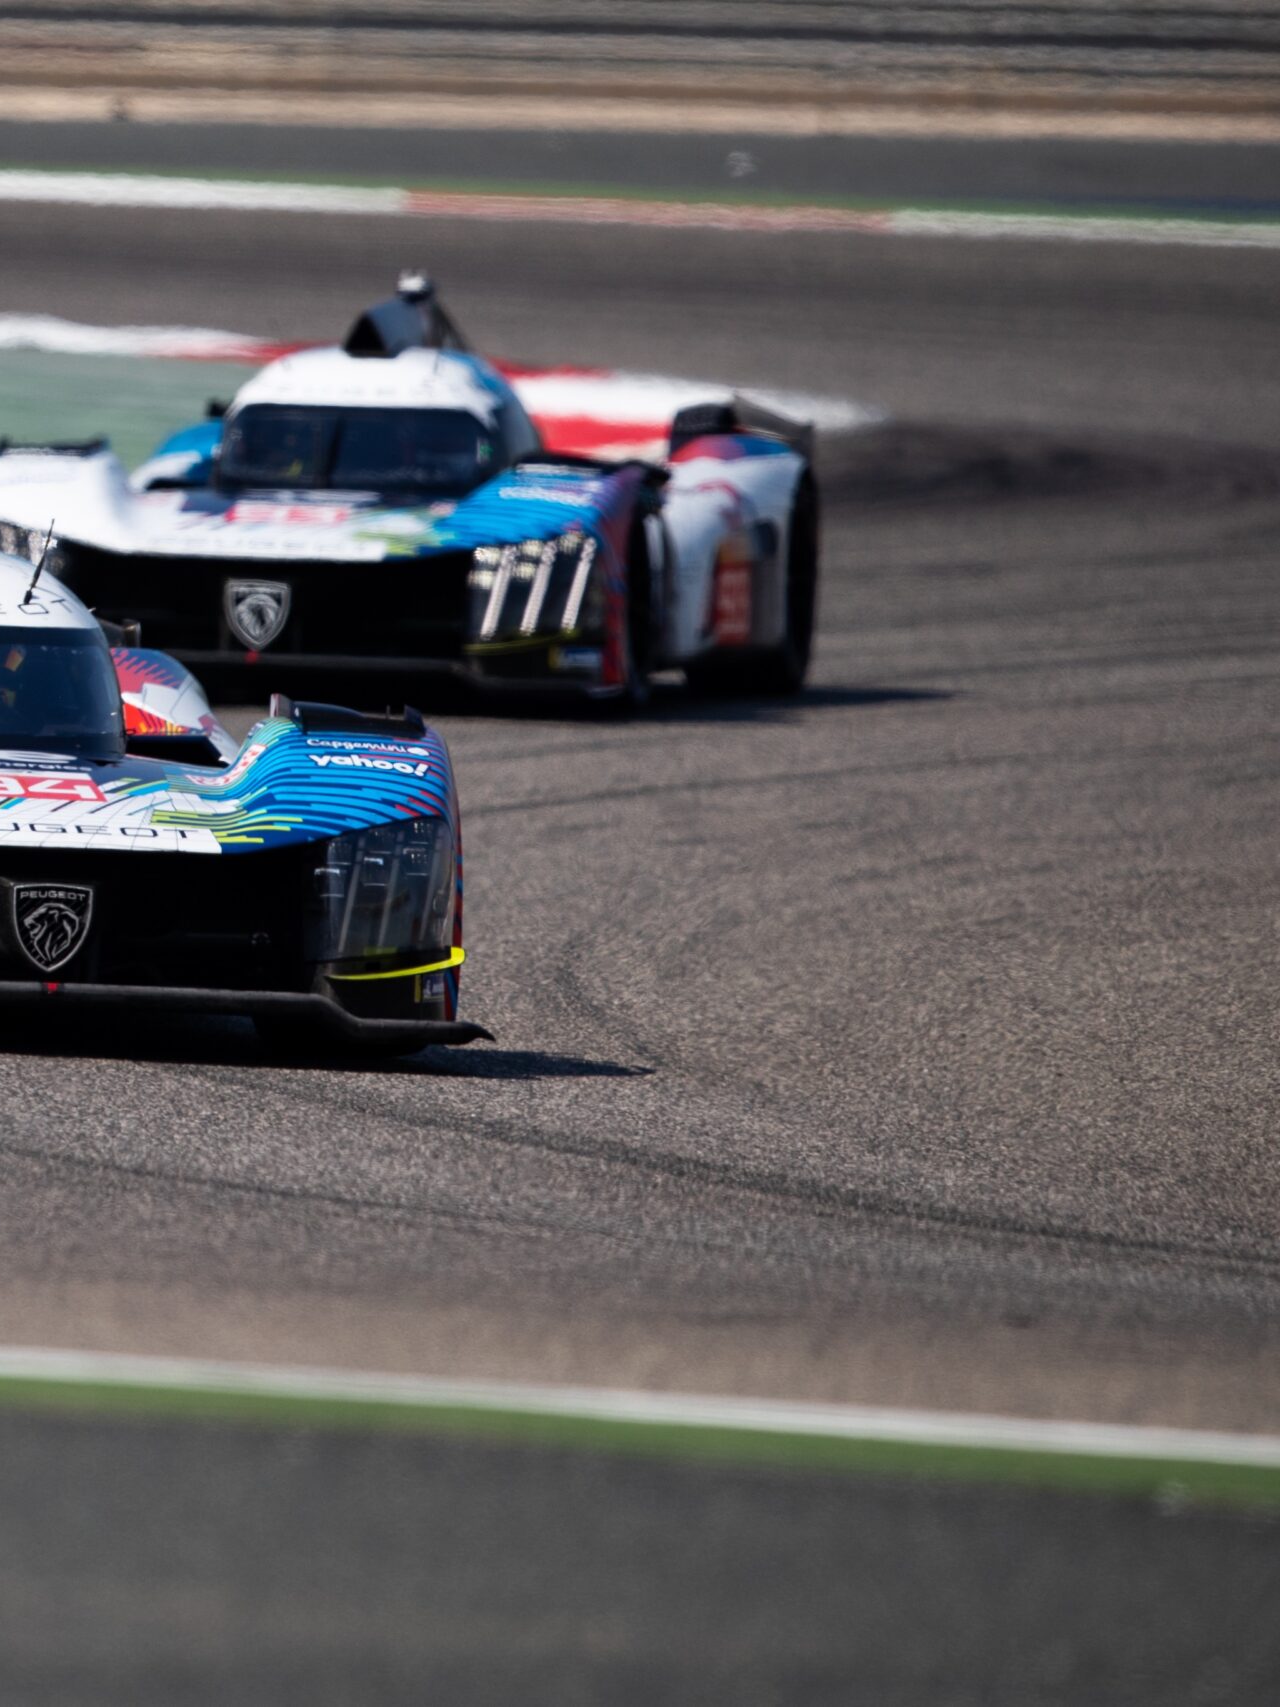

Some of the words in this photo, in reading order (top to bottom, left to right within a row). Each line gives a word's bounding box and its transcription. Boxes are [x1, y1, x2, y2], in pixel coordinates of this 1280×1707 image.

[307, 738, 407, 755] Capgemini
[309, 754, 429, 777] yahoo!
[20, 890, 87, 901] PEUGEOT
